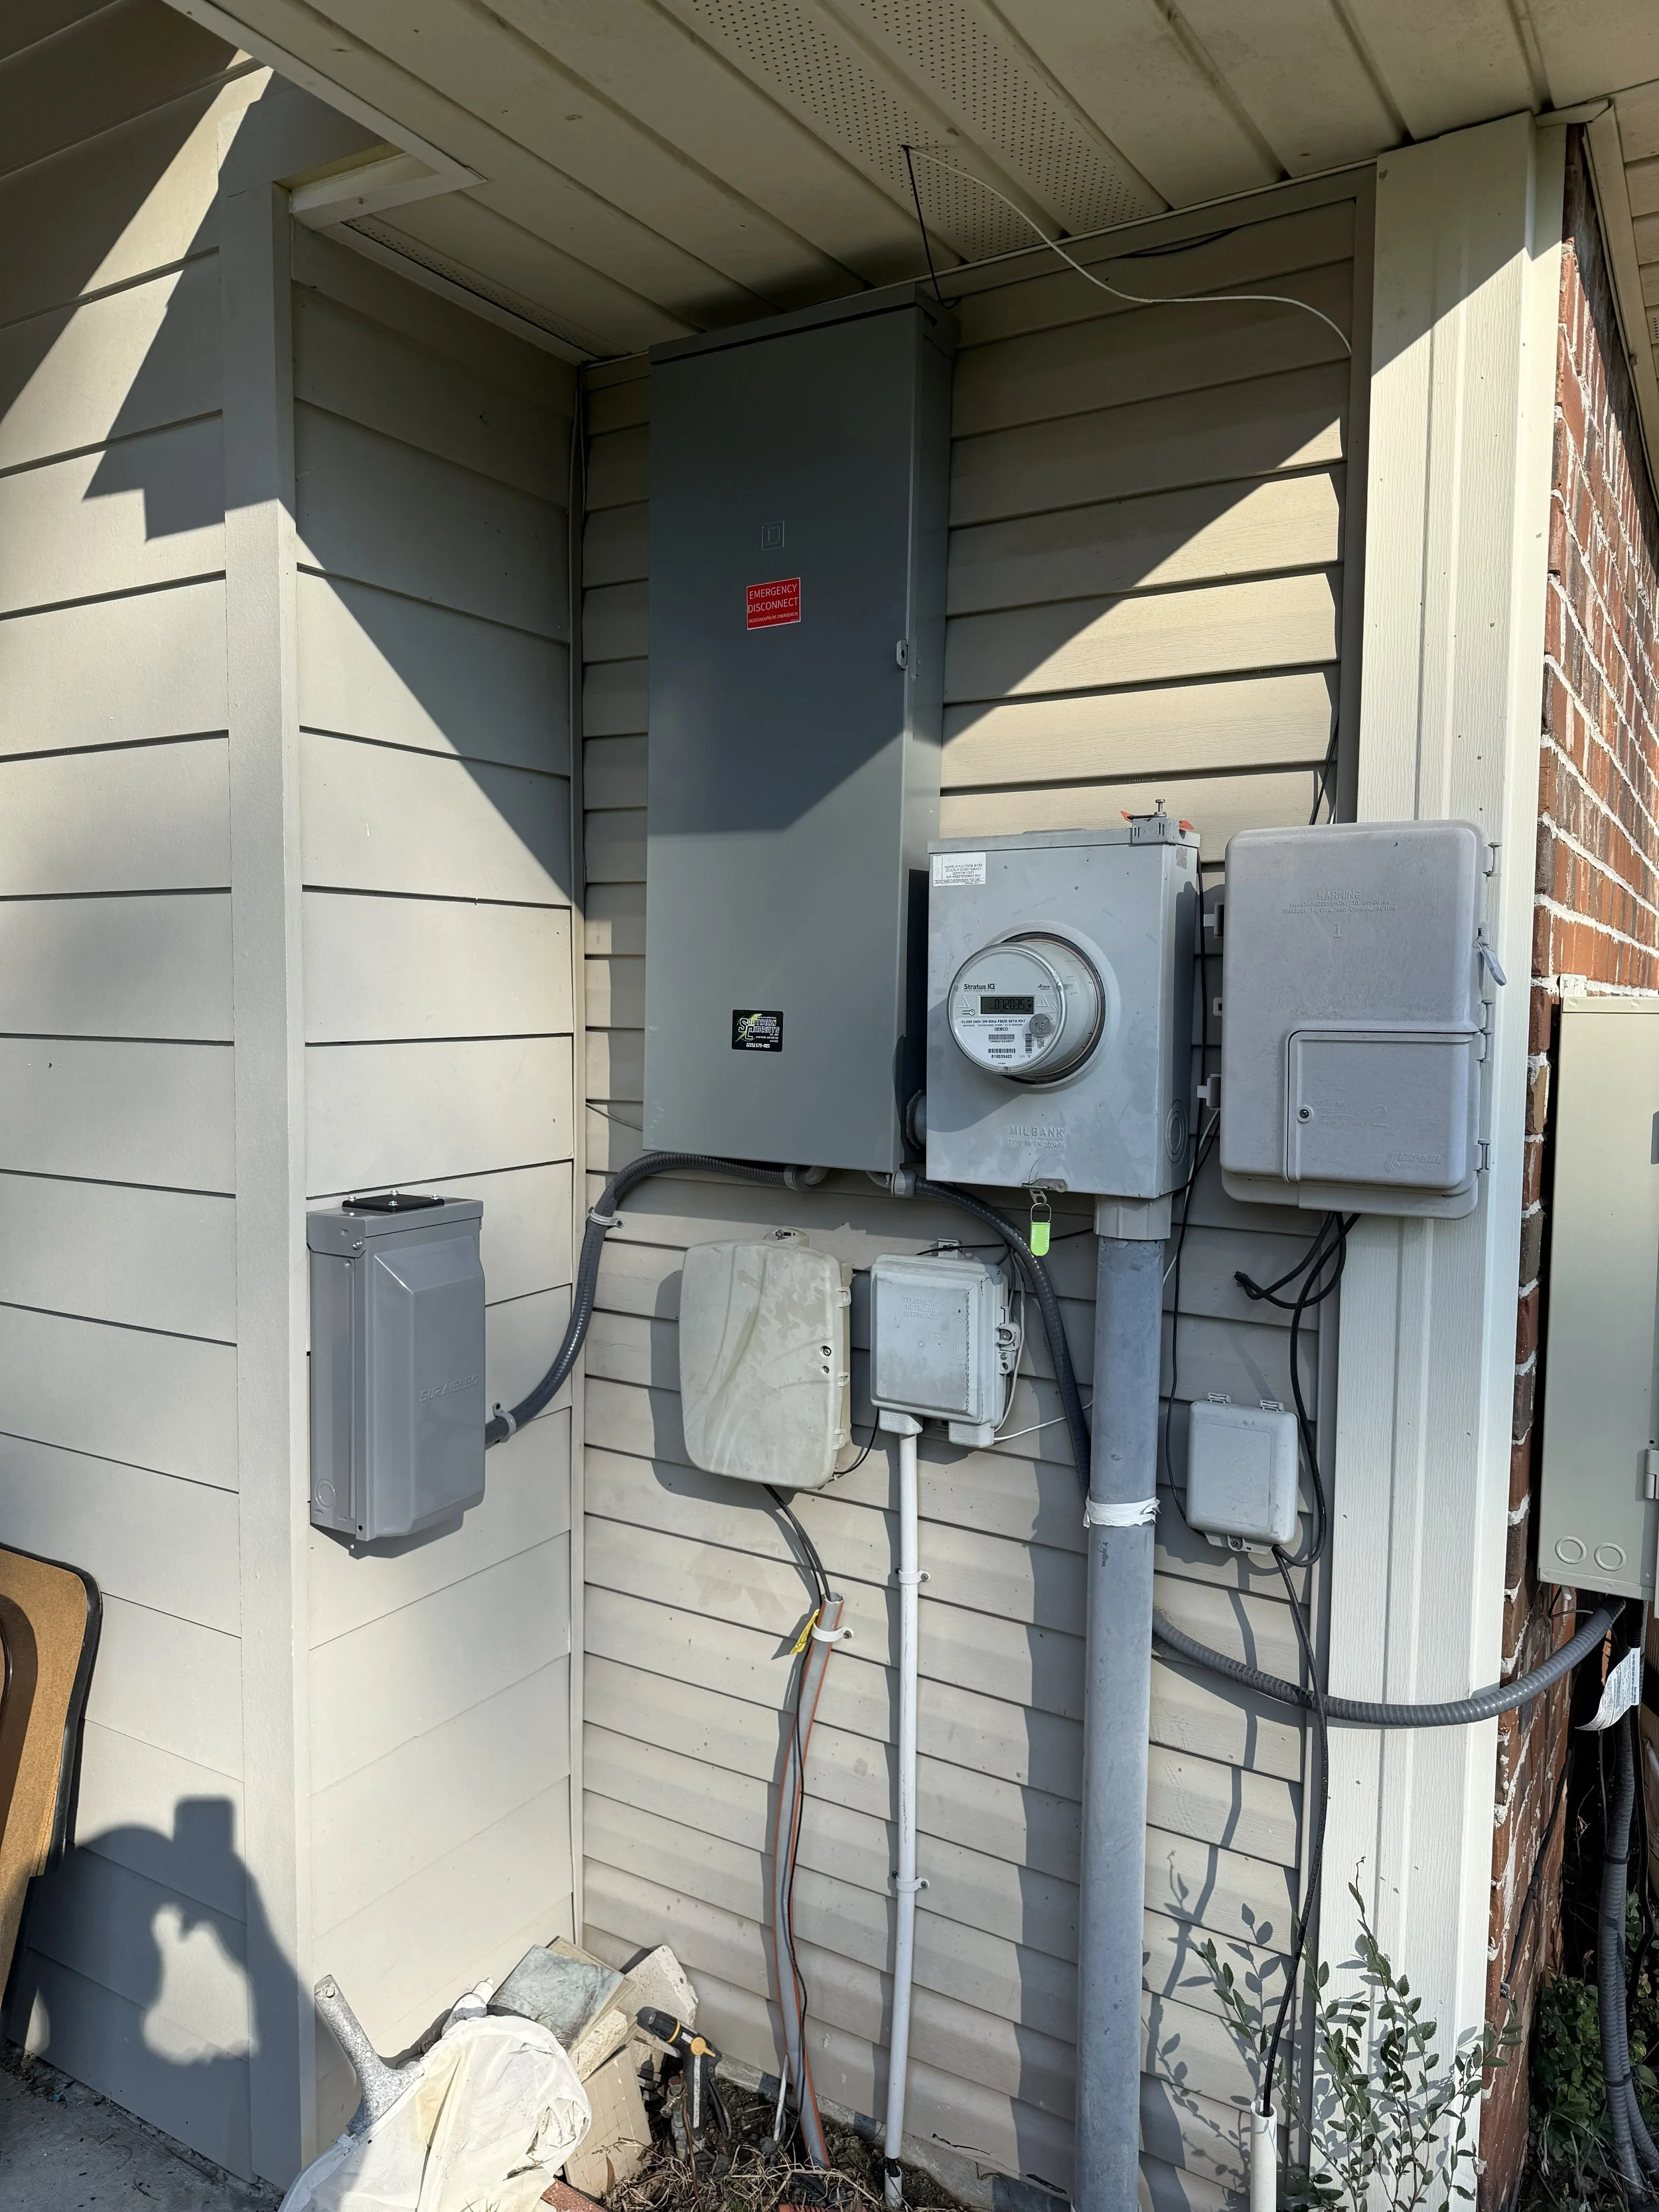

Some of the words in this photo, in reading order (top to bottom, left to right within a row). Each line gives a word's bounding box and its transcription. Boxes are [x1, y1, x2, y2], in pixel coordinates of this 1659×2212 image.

[749, 583, 797, 600] EMERGENCY
[748, 597, 799, 613] DISCONNECT
[1317, 889, 1361, 900] WARNING
[1333, 920, 1342, 938] 1
[1009, 1124, 1065, 1138] MILBANK
[1009, 1138, 1022, 1147] TYPE
[1034, 1140, 1066, 1149] ENCLOSURE
[902, 1296, 940, 1307] TELEPHONE
[904, 1303, 938, 1313] NETWORK
[903, 1310, 940, 1321] INTERFACE
